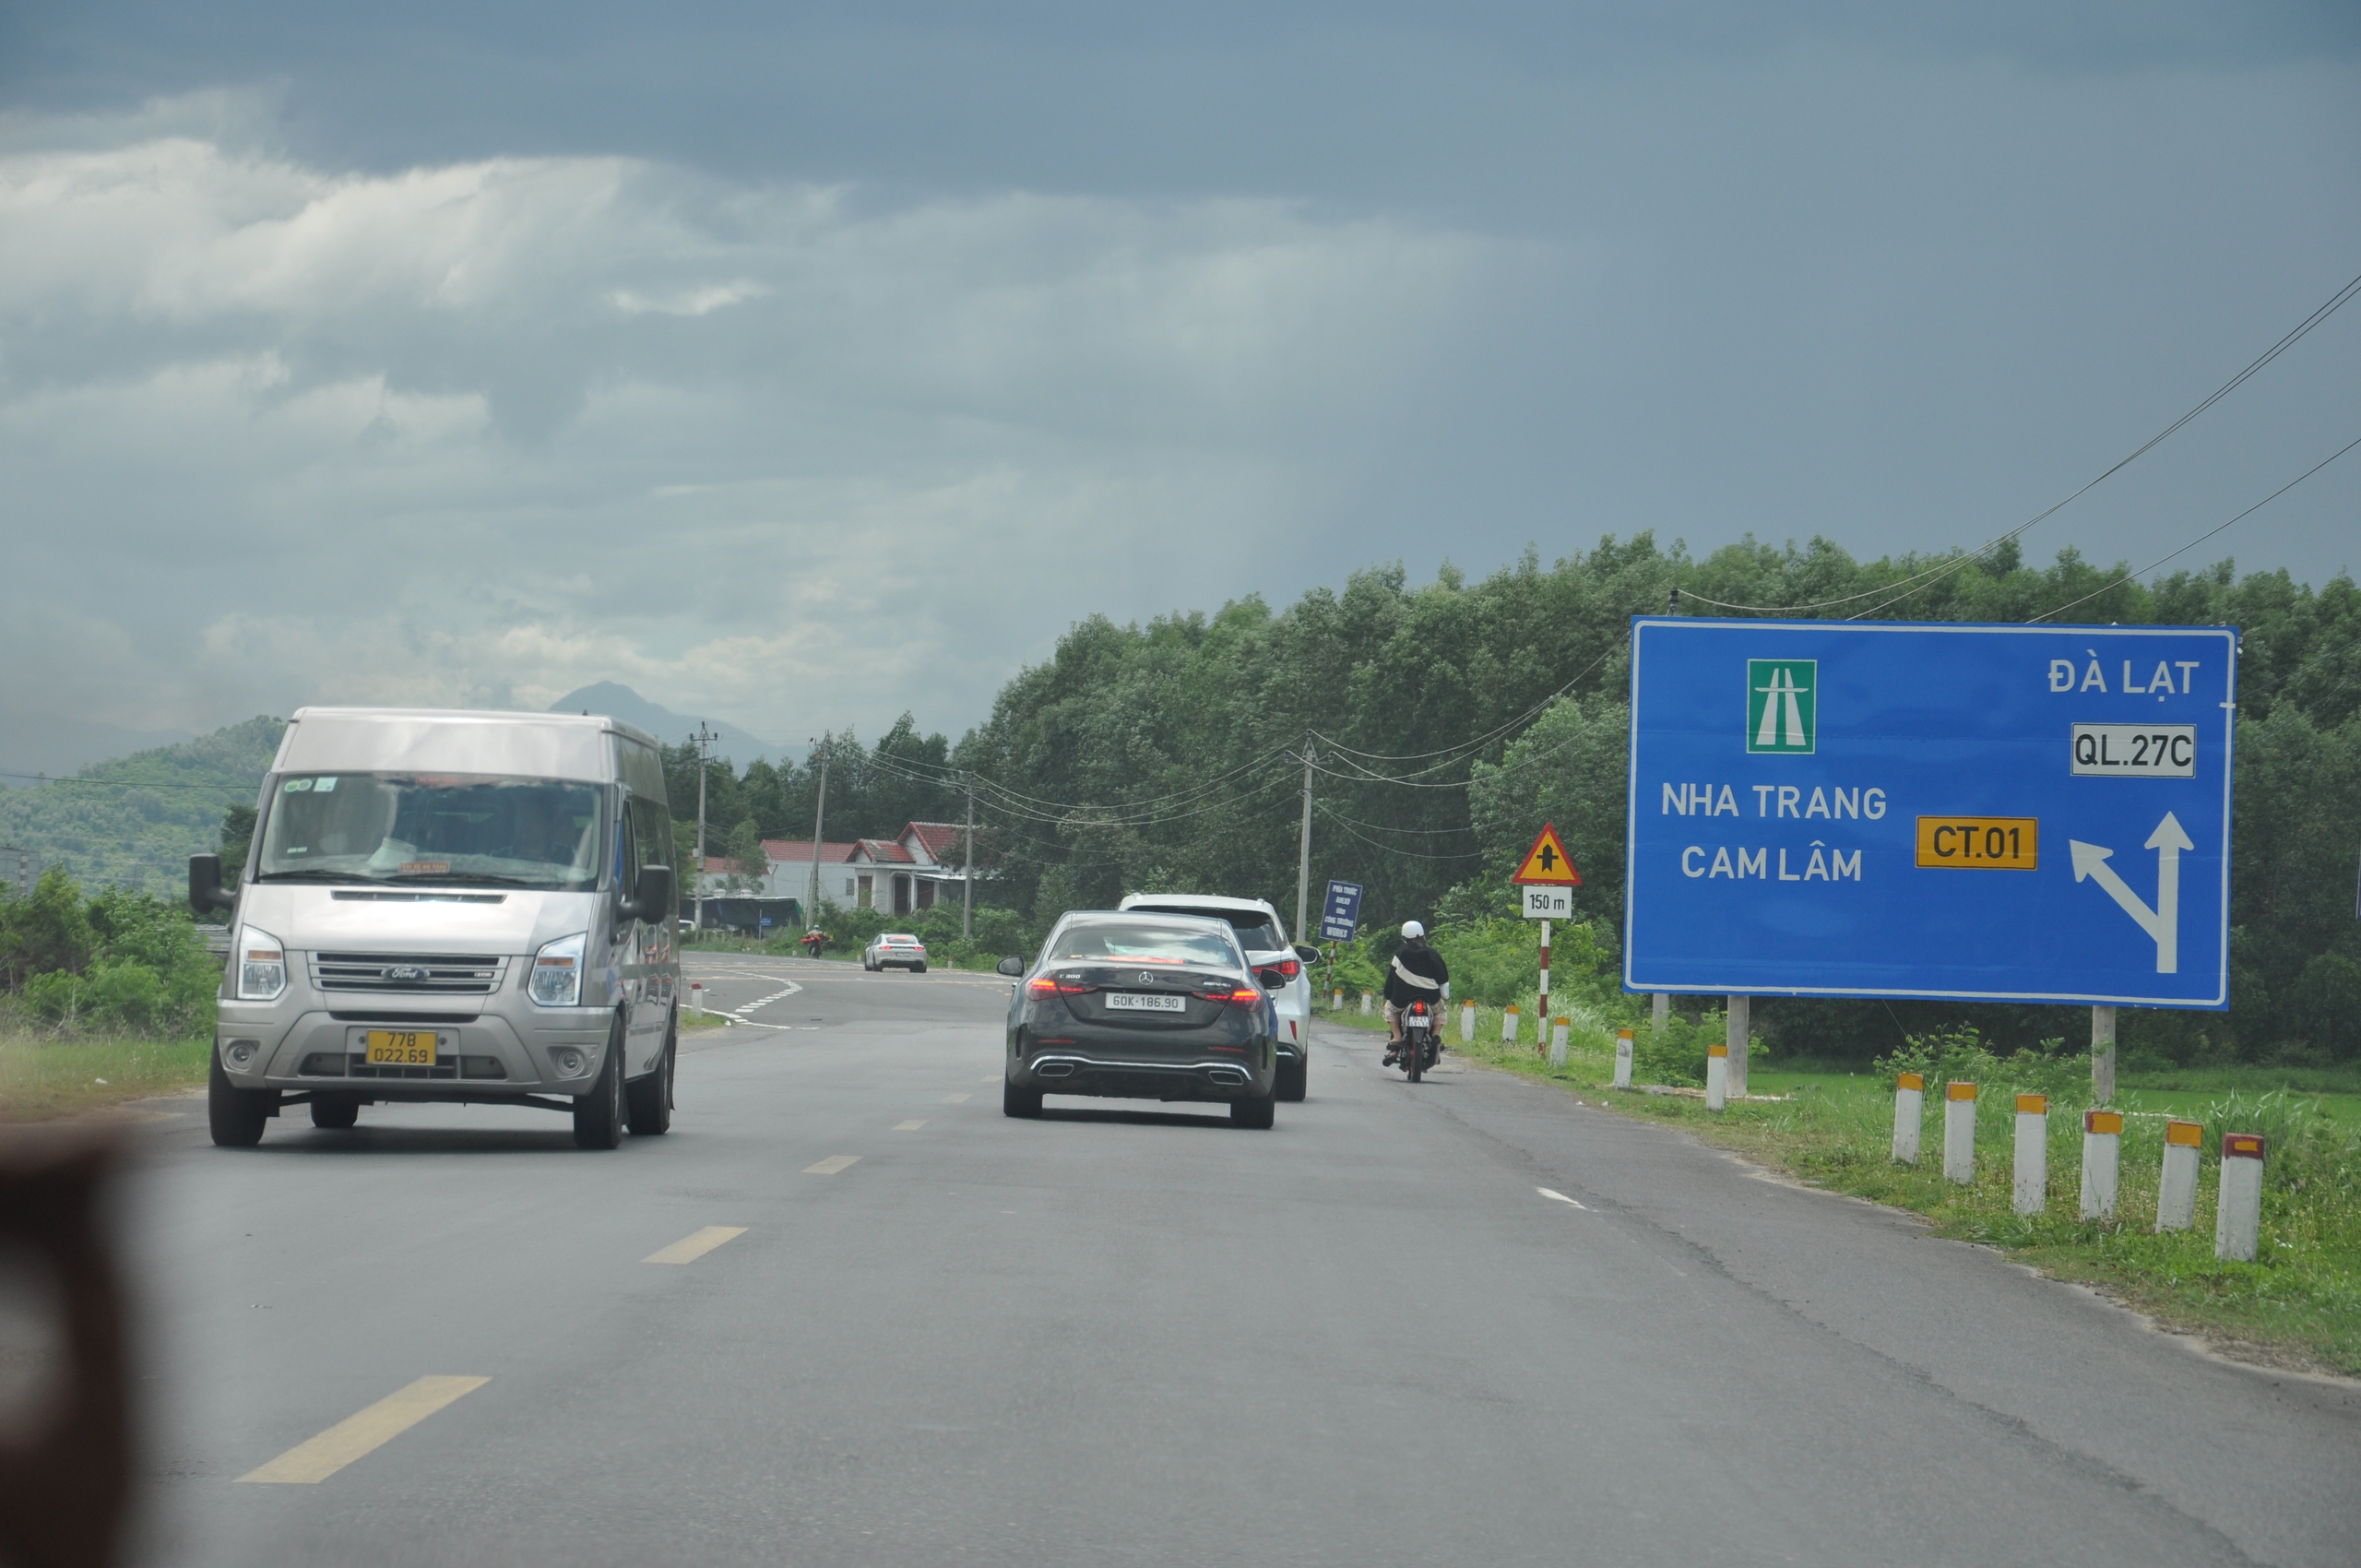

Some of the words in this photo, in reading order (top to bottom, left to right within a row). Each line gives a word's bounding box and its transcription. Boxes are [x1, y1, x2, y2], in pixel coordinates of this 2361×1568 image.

[2047, 649, 2106, 693] ĐÀ
[2123, 660, 2199, 702] LẠT
[2075, 733, 2192, 767] QL.27C
[1662, 782, 1739, 817] NHA
[1752, 785, 1886, 820] TRANG
[1933, 826, 2020, 860] CT.01
[1682, 846, 1767, 879] CAM
[1778, 840, 1862, 881] LÂM
[1529, 894, 1549, 909] 150
[1553, 898, 1565, 910] m
[1327, 926, 1347, 938] WORKS
[391, 967, 418, 979] Ford
[1112, 995, 1179, 1009] 60K-186.90
[387, 1032, 417, 1047] 77B
[374, 1048, 428, 1063] 022.69
